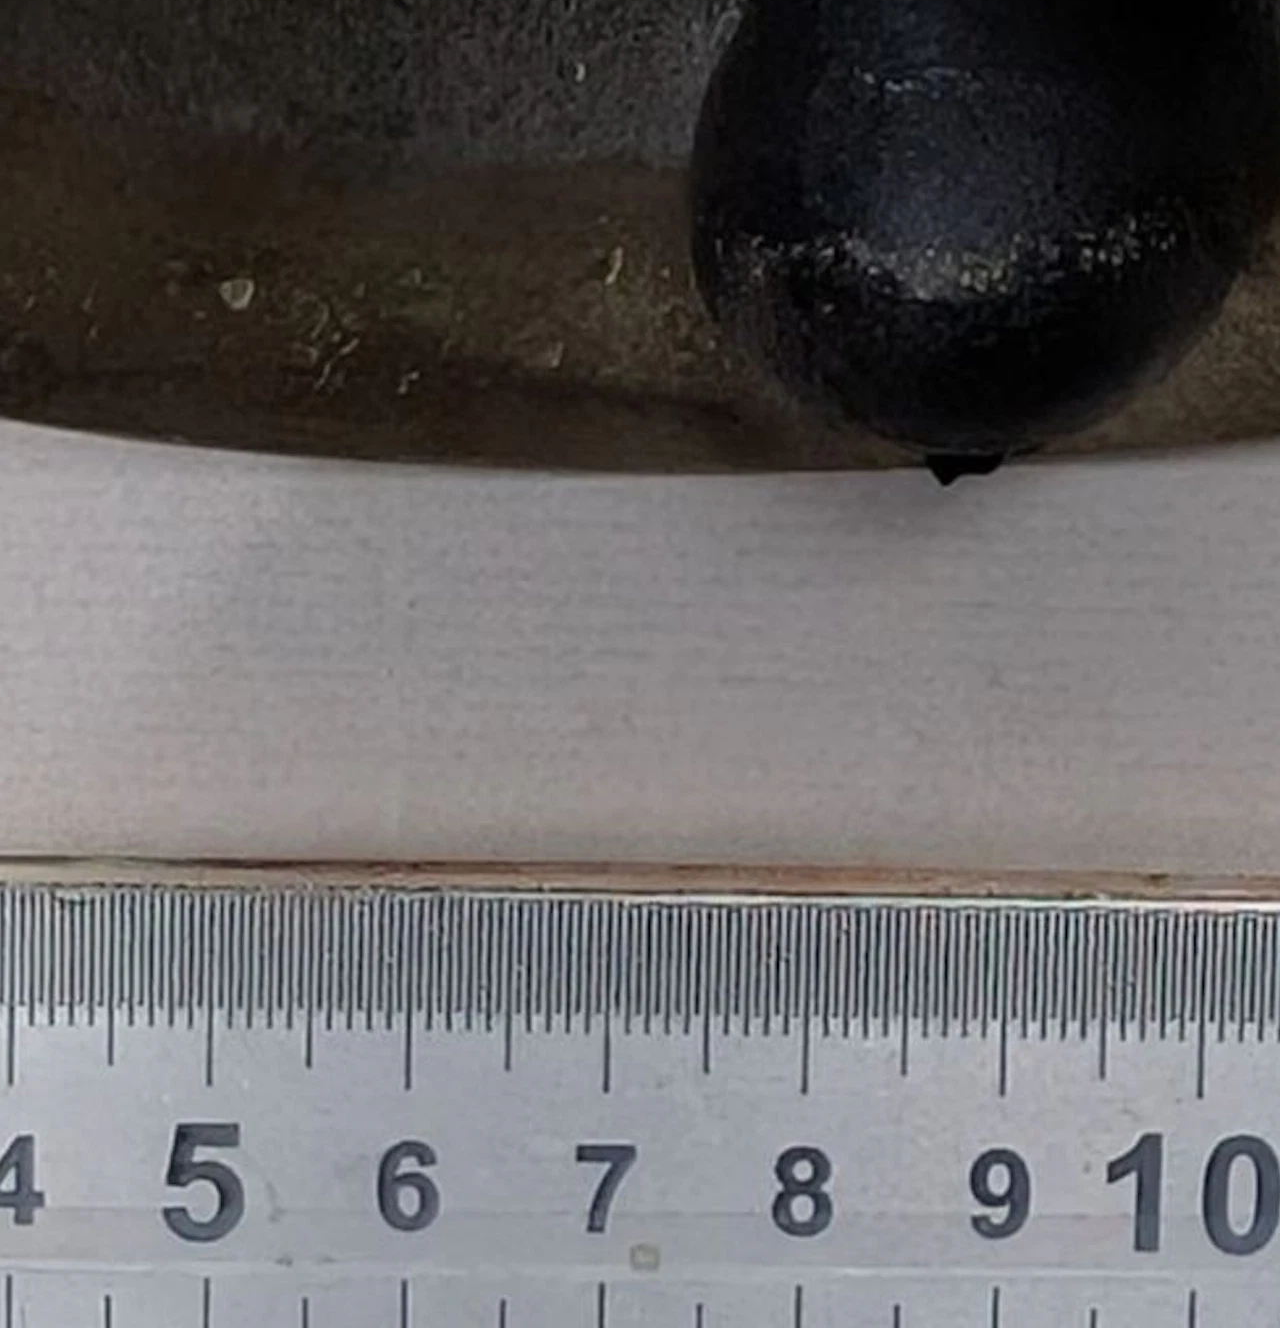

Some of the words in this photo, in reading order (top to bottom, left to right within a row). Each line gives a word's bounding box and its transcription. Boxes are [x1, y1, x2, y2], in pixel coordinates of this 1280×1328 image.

[161, 1122, 245, 1243] 5
[376, 1140, 439, 1233] 6
[574, 1144, 637, 1234] 7
[771, 1146, 833, 1238] 8
[969, 1148, 1031, 1240] 9
